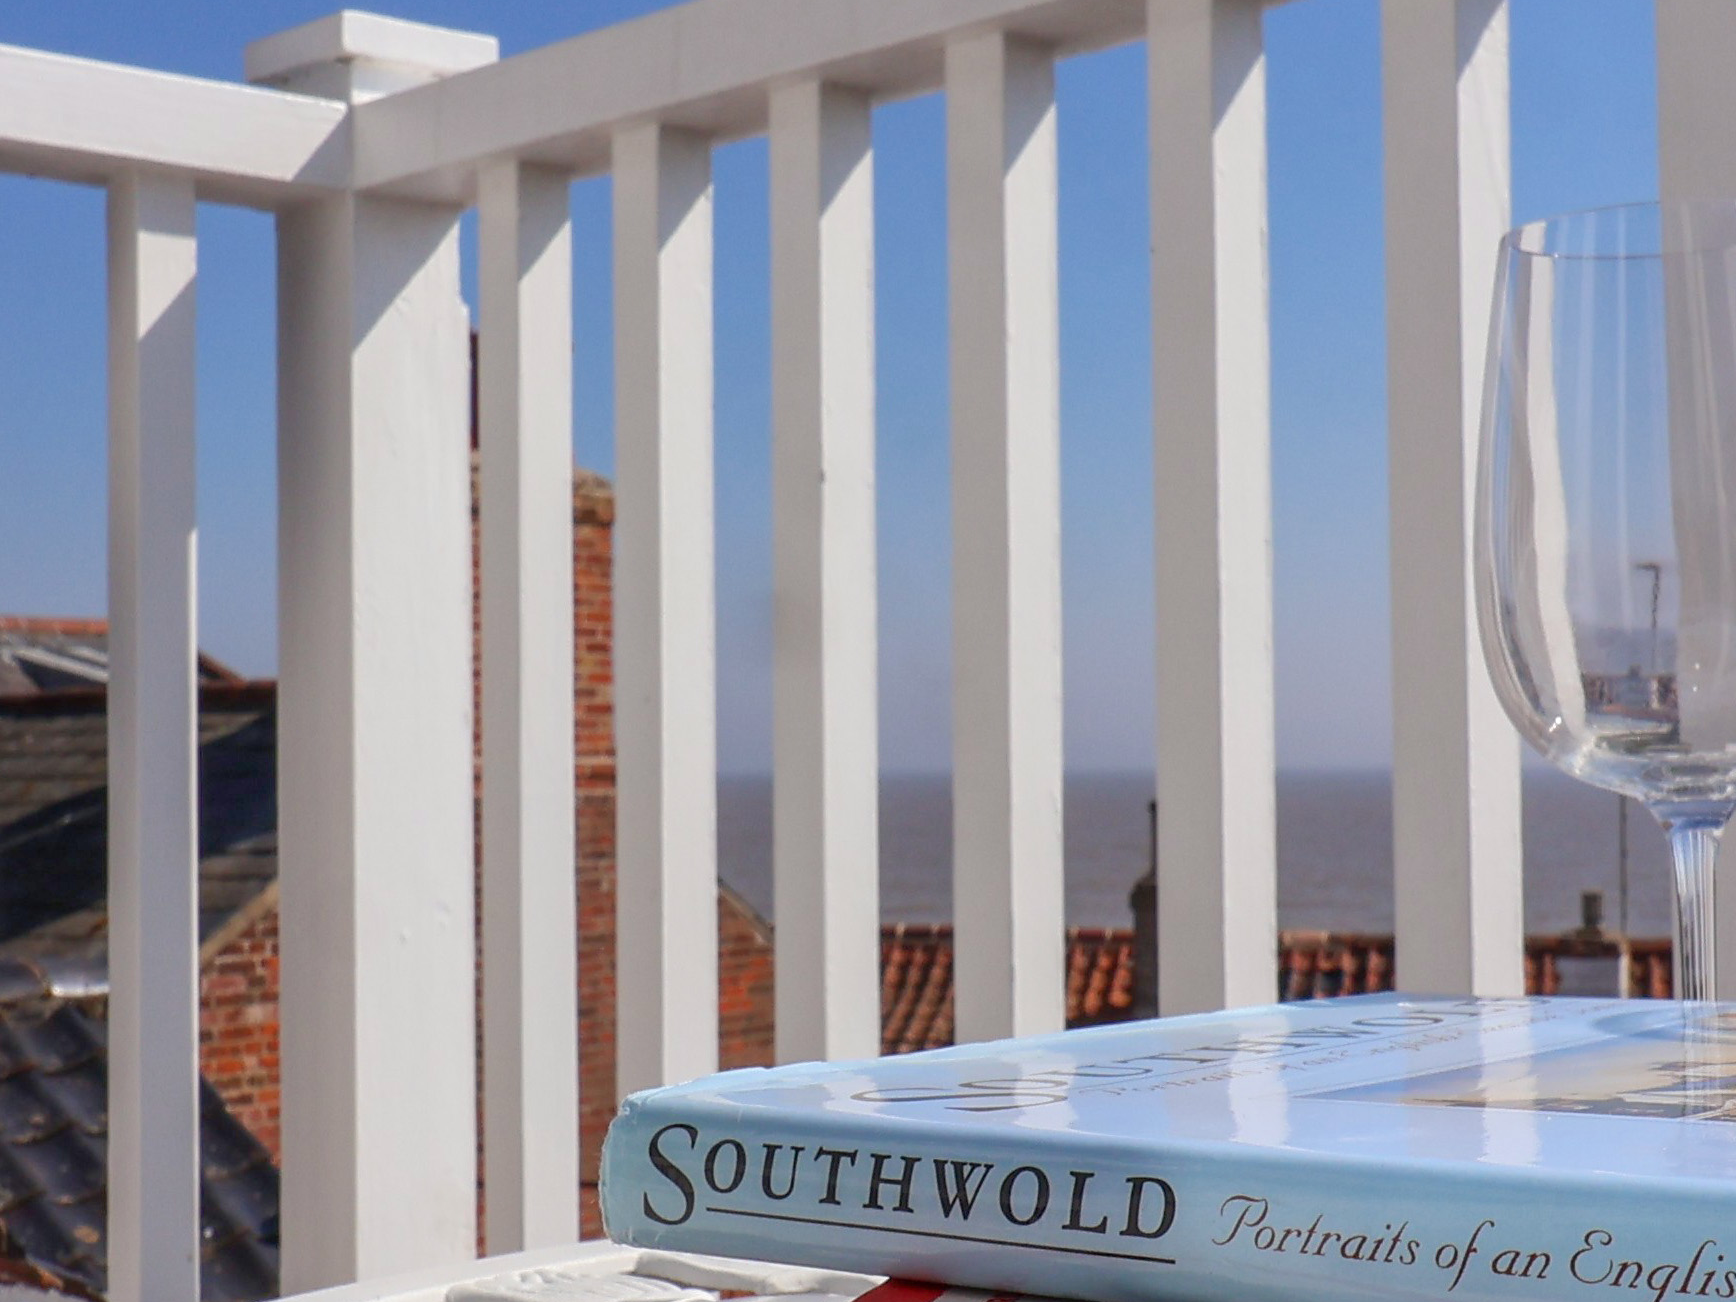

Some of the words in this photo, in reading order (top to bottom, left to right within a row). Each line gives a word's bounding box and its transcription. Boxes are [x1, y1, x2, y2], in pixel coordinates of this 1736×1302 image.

[641, 1122, 1179, 1241] SOUTHWOLD
[1211, 1195, 1420, 1267] Portraits
[1434, 1219, 1496, 1293] of
[1490, 1246, 1552, 1282] an
